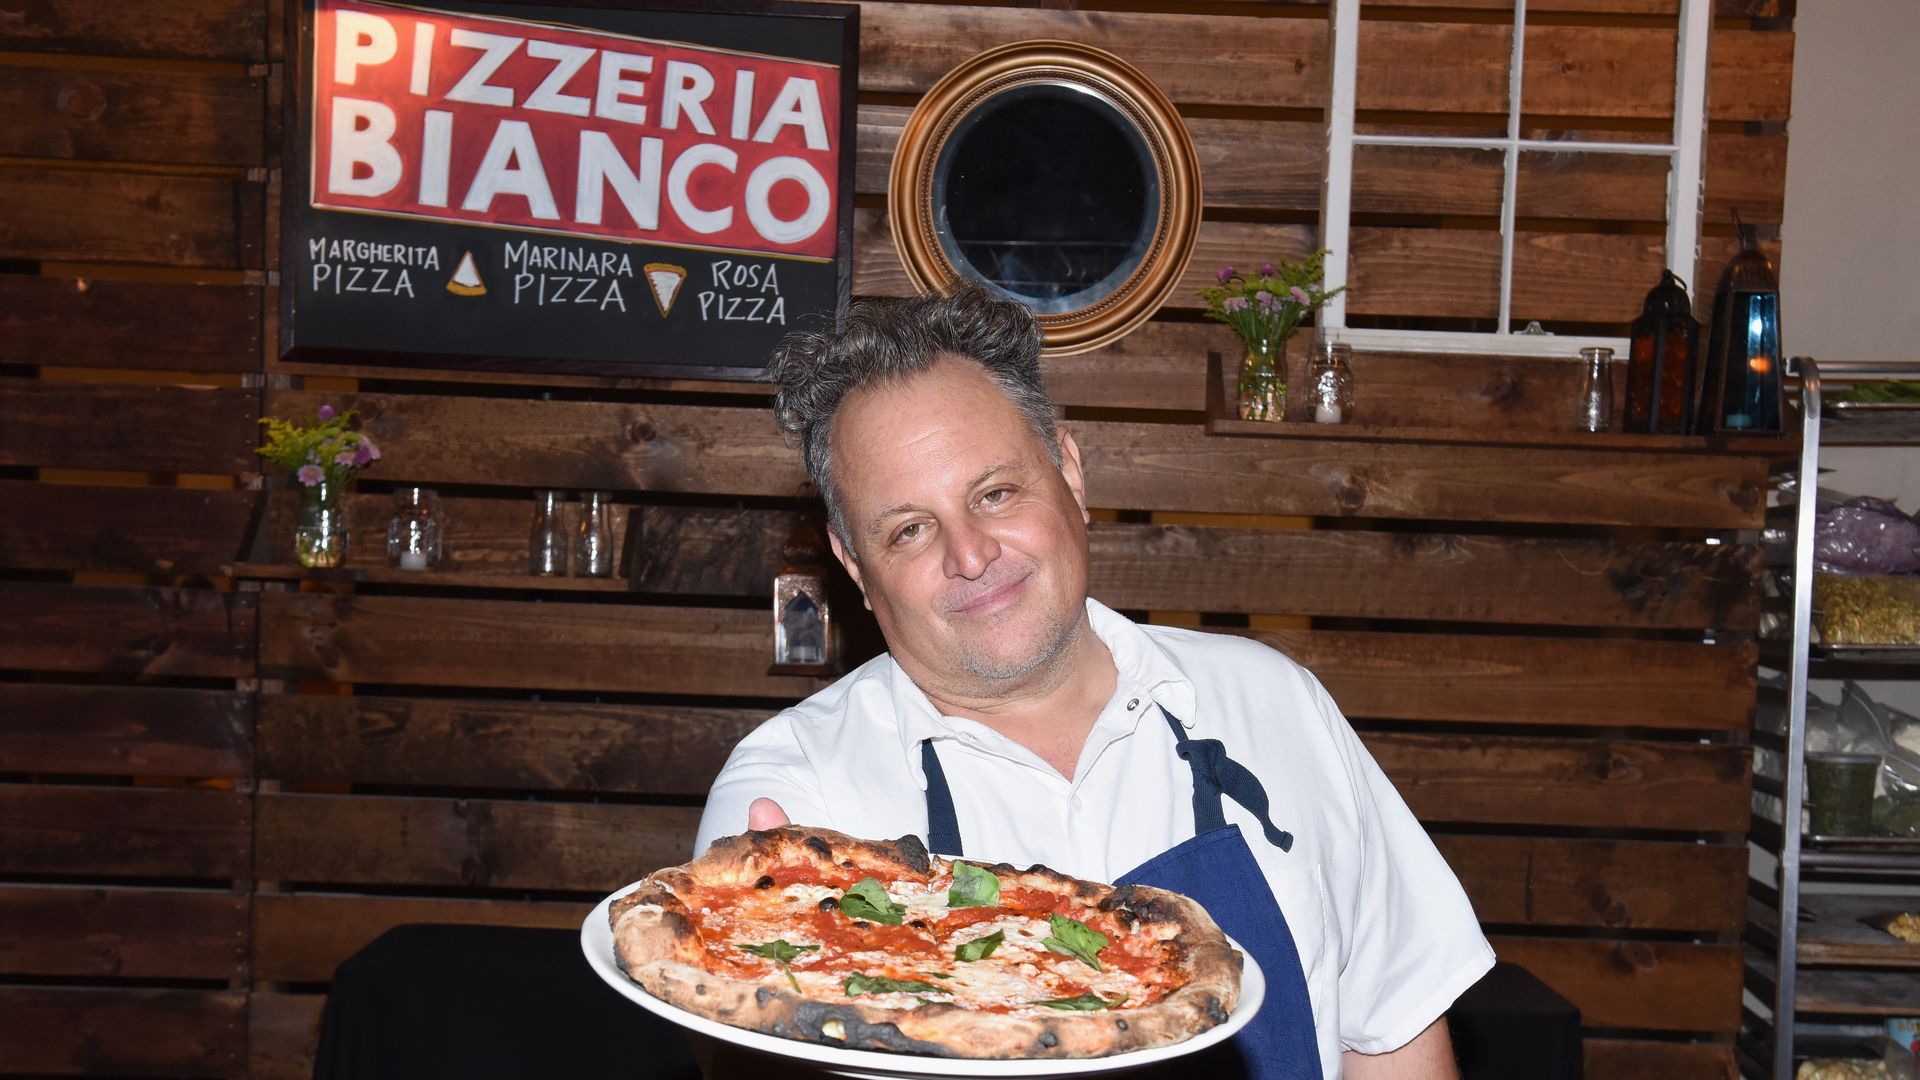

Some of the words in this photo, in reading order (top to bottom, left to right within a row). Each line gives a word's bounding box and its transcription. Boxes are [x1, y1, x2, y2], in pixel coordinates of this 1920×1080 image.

[333, 9, 830, 151] PIZZERIA
[328, 96, 831, 244] BIANCO
[309, 237, 440, 271] MARGHERITA
[504, 240, 633, 277] MARINARA
[313, 263, 415, 298] PIZZA
[514, 273, 626, 312] PIZZA
[711, 260, 779, 295] ROSA
[698, 291, 785, 325] PIZZA
